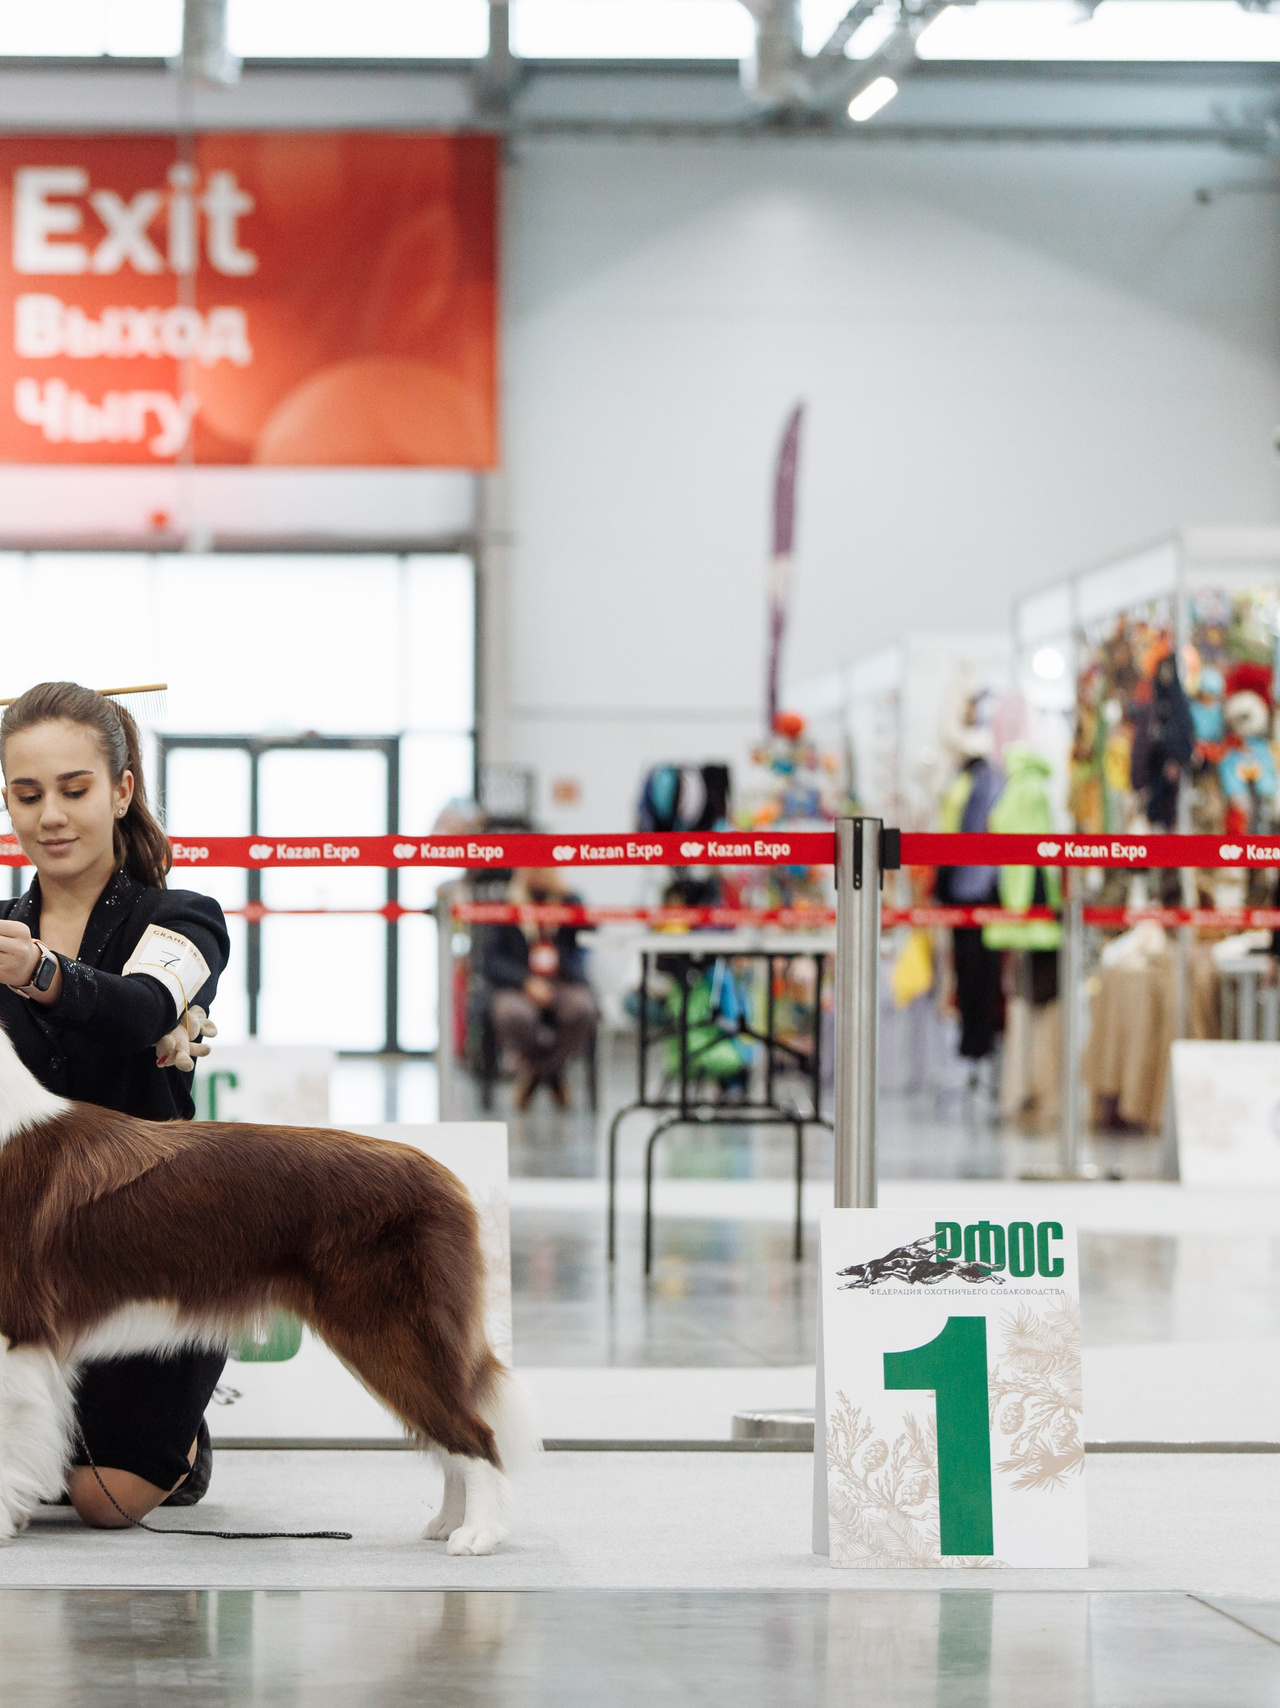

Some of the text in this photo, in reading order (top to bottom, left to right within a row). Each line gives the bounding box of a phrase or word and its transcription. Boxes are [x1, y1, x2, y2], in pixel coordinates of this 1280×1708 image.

[14, 165, 256, 275] Exit
[14, 294, 253, 365] Выход
[14, 378, 199, 456] Чыгу
[172, 842, 209, 862] Expo
[277, 842, 359, 862] Kazan Expo
[421, 842, 503, 861] Kazan Expo
[580, 842, 662, 860] Kazan Expo
[708, 840, 790, 859] Kazan Expo
[1065, 841, 1146, 860] Kazan Expo
[1247, 845, 1280, 859] Kaza
[935, 1221, 1064, 1278] РФОС
[869, 1288, 1066, 1296] ФЕДЕРАЦИЯ ОХОТНИЧЬЕГО СОБАКОВОДСТВА
[883, 1316, 994, 1556] 1
